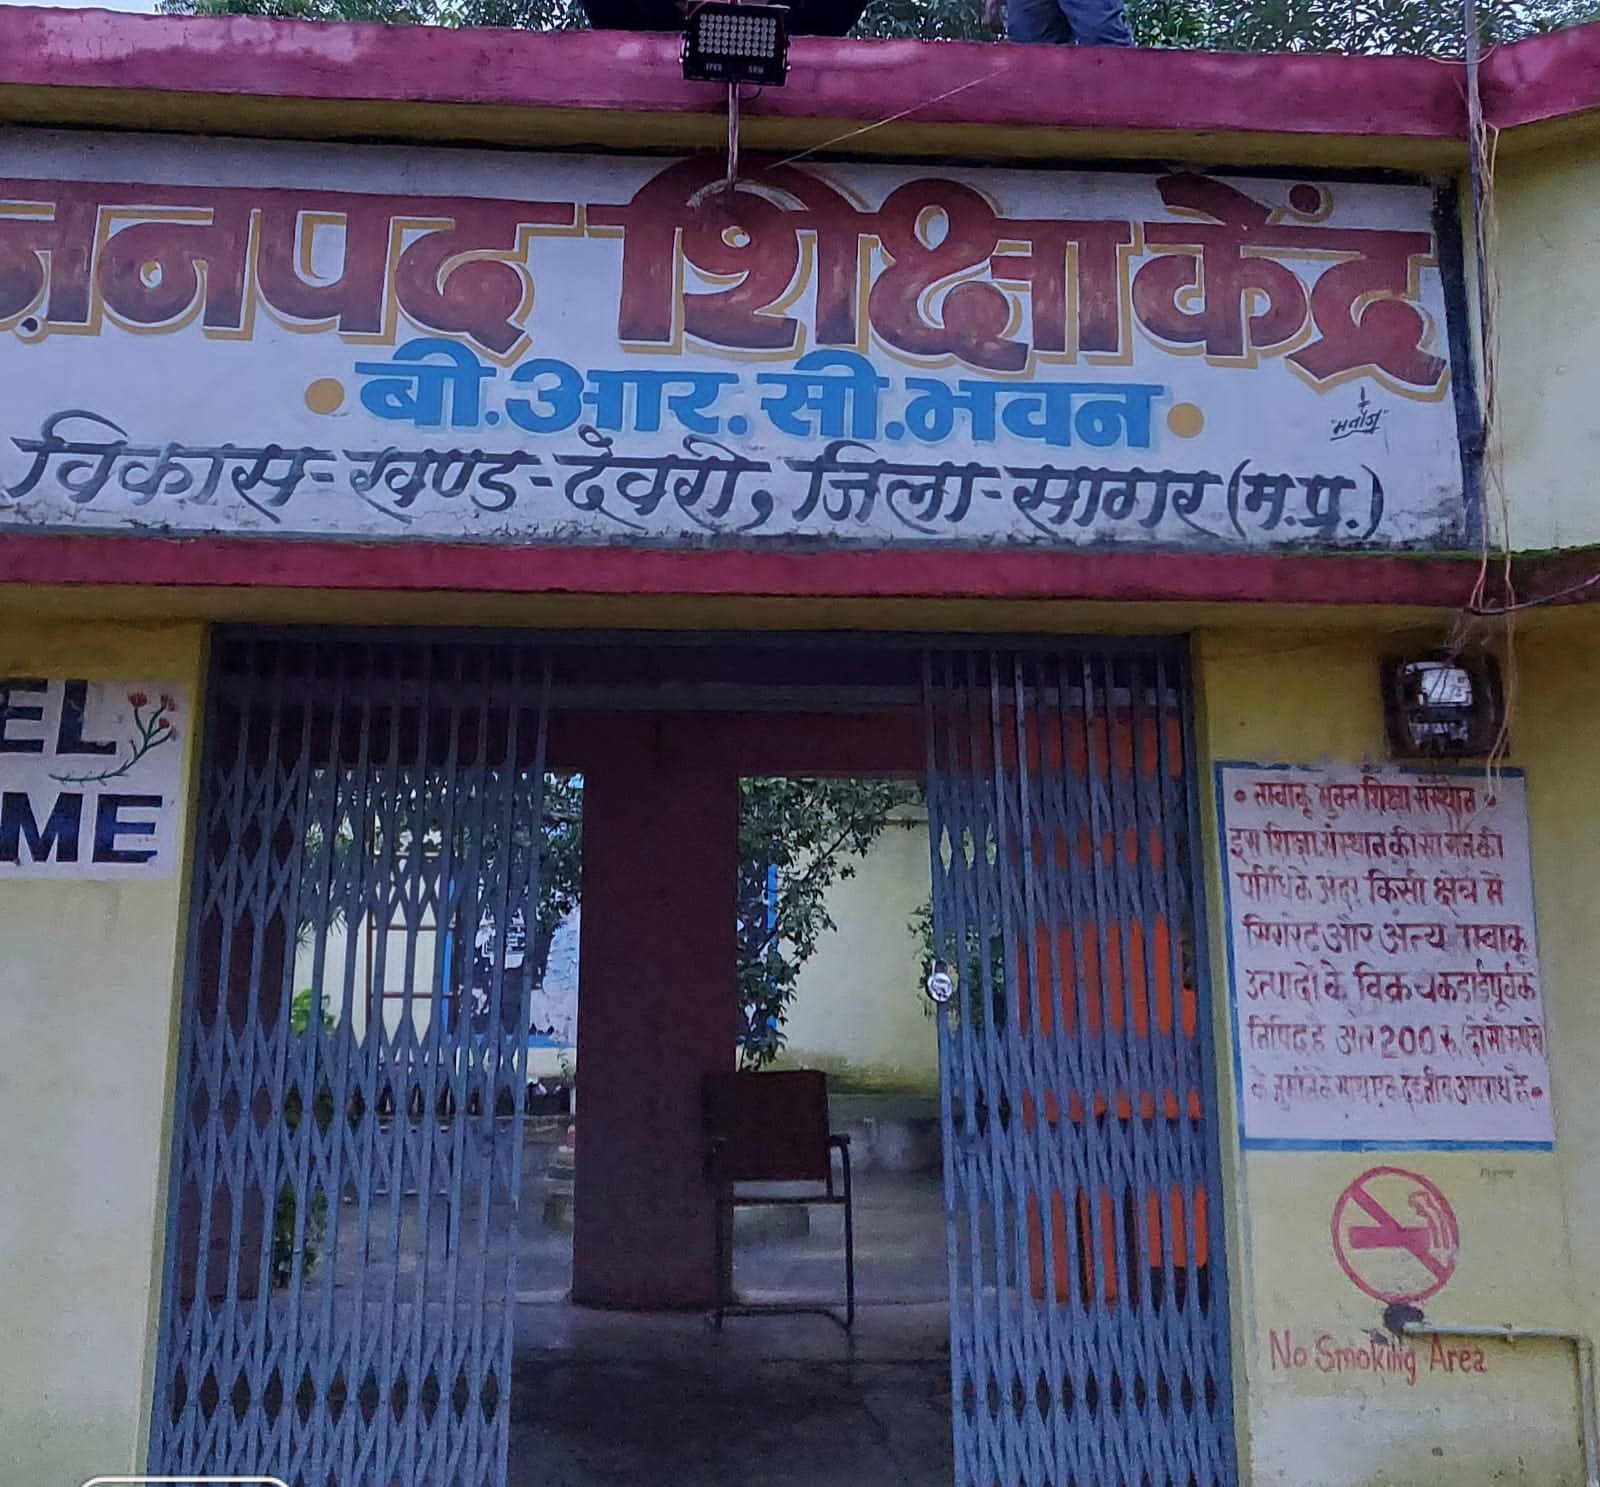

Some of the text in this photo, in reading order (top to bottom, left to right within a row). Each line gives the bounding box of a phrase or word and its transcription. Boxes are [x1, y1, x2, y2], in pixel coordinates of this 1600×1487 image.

[1380, 1025, 1436, 1058] 200
[1269, 1330, 1487, 1386] No Smoking Area
